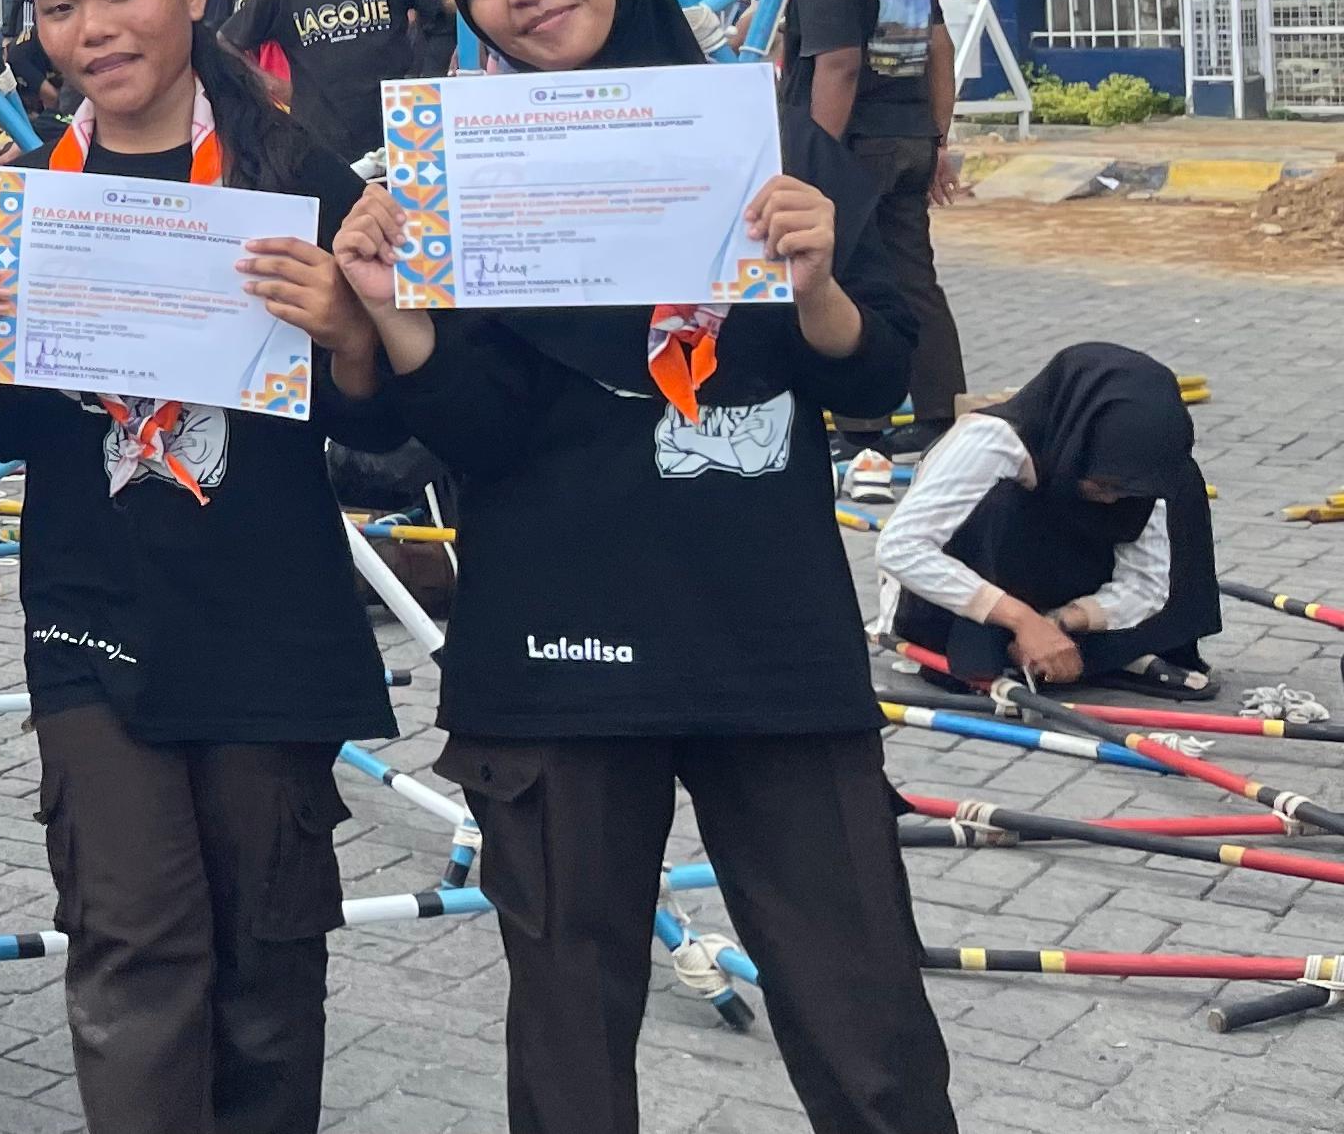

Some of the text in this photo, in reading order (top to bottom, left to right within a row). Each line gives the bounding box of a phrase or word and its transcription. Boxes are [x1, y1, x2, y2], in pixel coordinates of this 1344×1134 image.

[454, 107, 653, 128] PIAGAM PENGHARGAAN
[32, 207, 208, 232] PIAGAM PENGHARGAAN
[527, 635, 633, 663] Lalalisa
